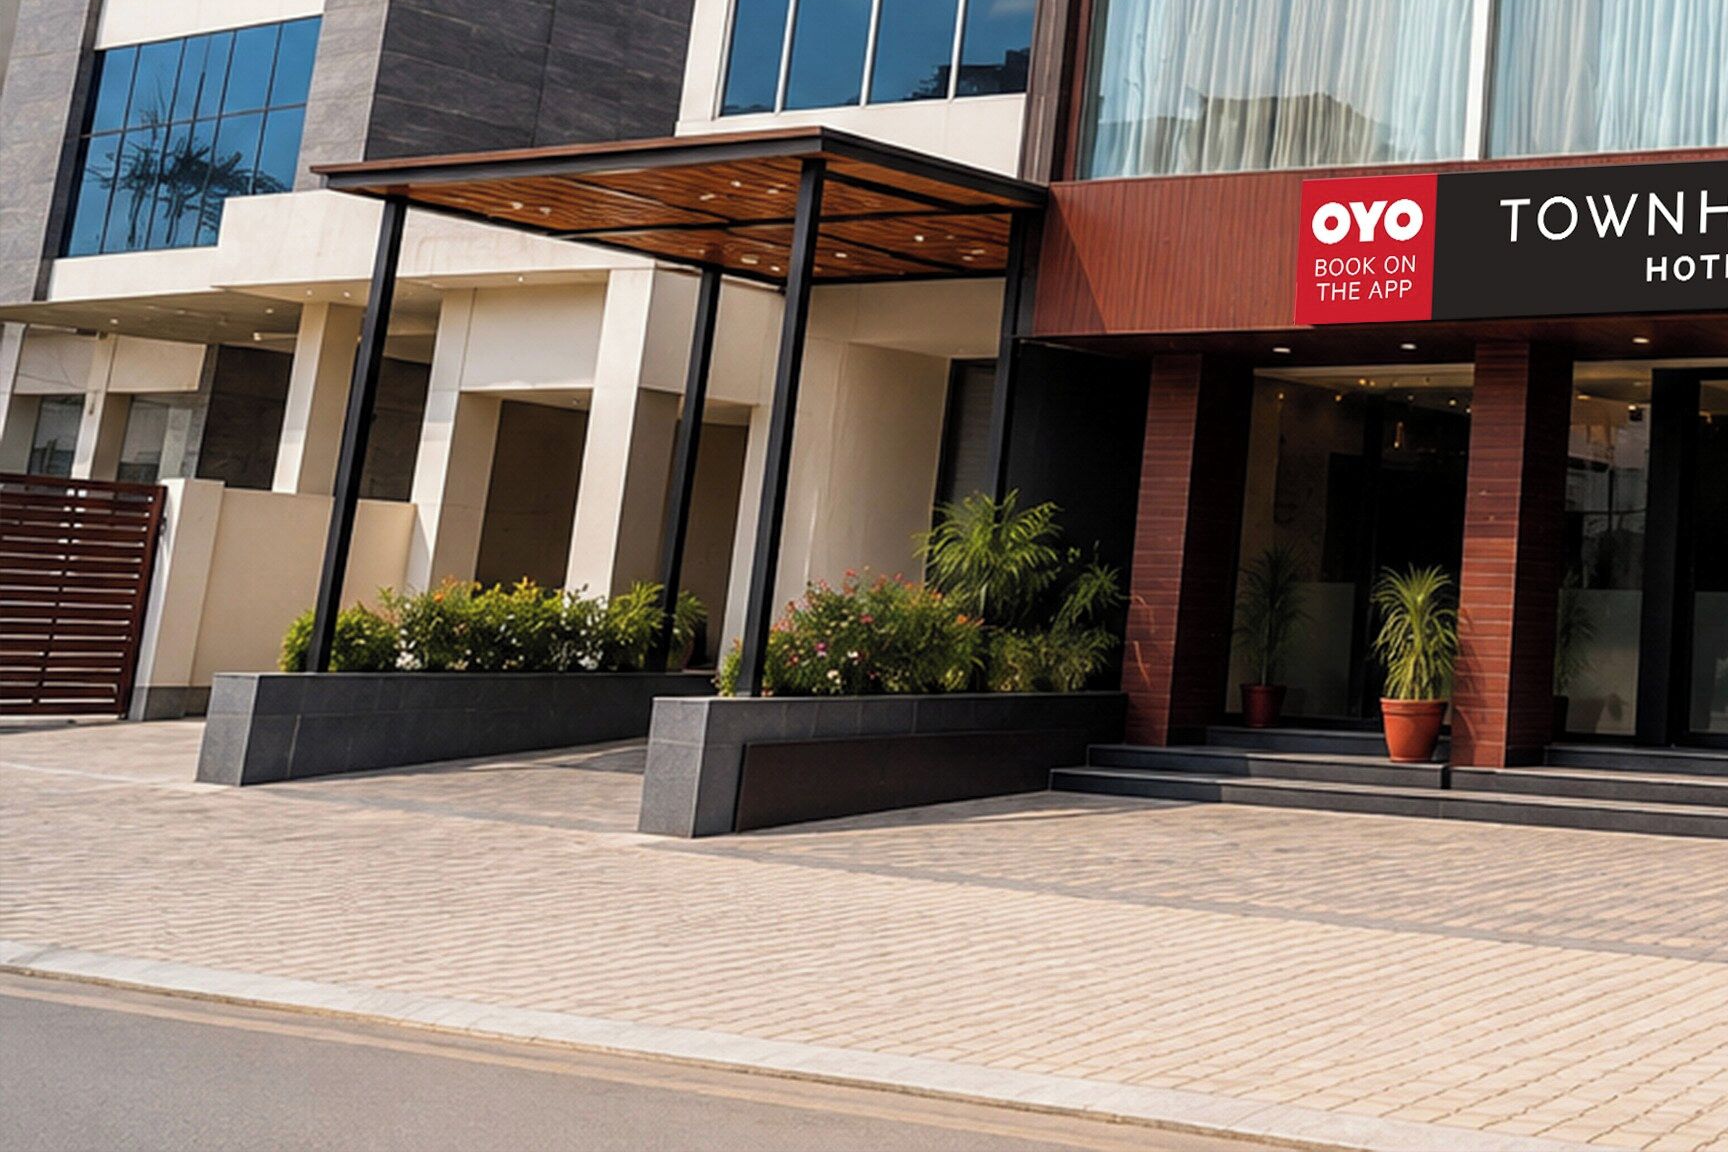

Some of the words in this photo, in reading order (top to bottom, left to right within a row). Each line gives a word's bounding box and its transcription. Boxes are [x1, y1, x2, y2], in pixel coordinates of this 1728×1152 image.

[1311, 198, 1424, 245] OYO
[1314, 256, 1376, 277] BOOK
[1383, 254, 1416, 275] ON
[1316, 281, 1361, 302] THE
[1368, 279, 1413, 300] APP
